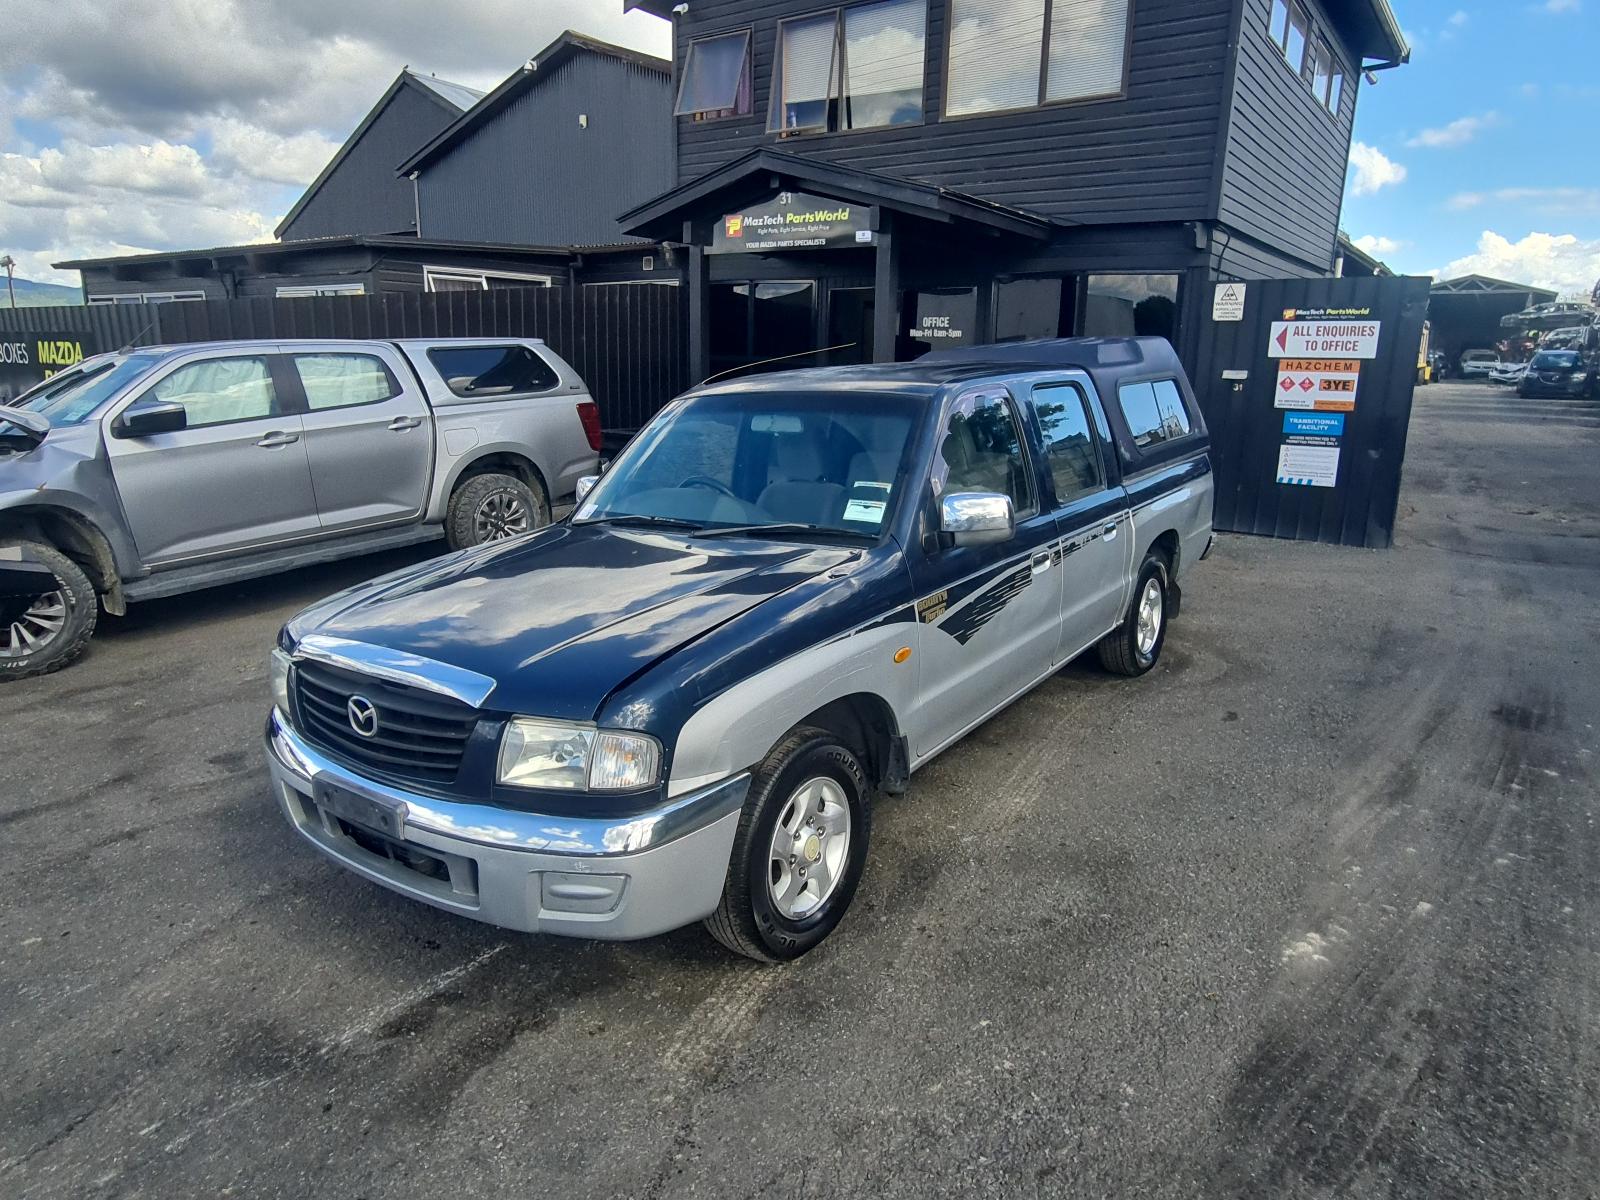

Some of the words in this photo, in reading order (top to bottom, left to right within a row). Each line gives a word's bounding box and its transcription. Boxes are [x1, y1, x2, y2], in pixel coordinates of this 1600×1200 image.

[780, 192, 792, 204] 31
[743, 215, 784, 227] MazTech
[786, 208, 850, 224] PartsWorld
[794, 238, 826, 246] SPECIALISTS
[1296, 308, 1325, 316] MazTech
[1326, 307, 1370, 315] PartsWorld
[922, 316, 950, 328] OFFICE
[909, 329, 933, 337] Mon-Fri
[933, 329, 962, 338] 8am-5pm
[1293, 325, 1311, 337] ALL
[1316, 325, 1376, 338] ENQUIRIES
[1305, 340, 1318, 351] TO
[1321, 340, 1359, 352] OFFICE
[38, 340, 84, 365] MAZDA
[1286, 361, 1353, 371] HAZCHEM
[1232, 383, 1243, 392] 31
[1323, 380, 1350, 391] 3YE
